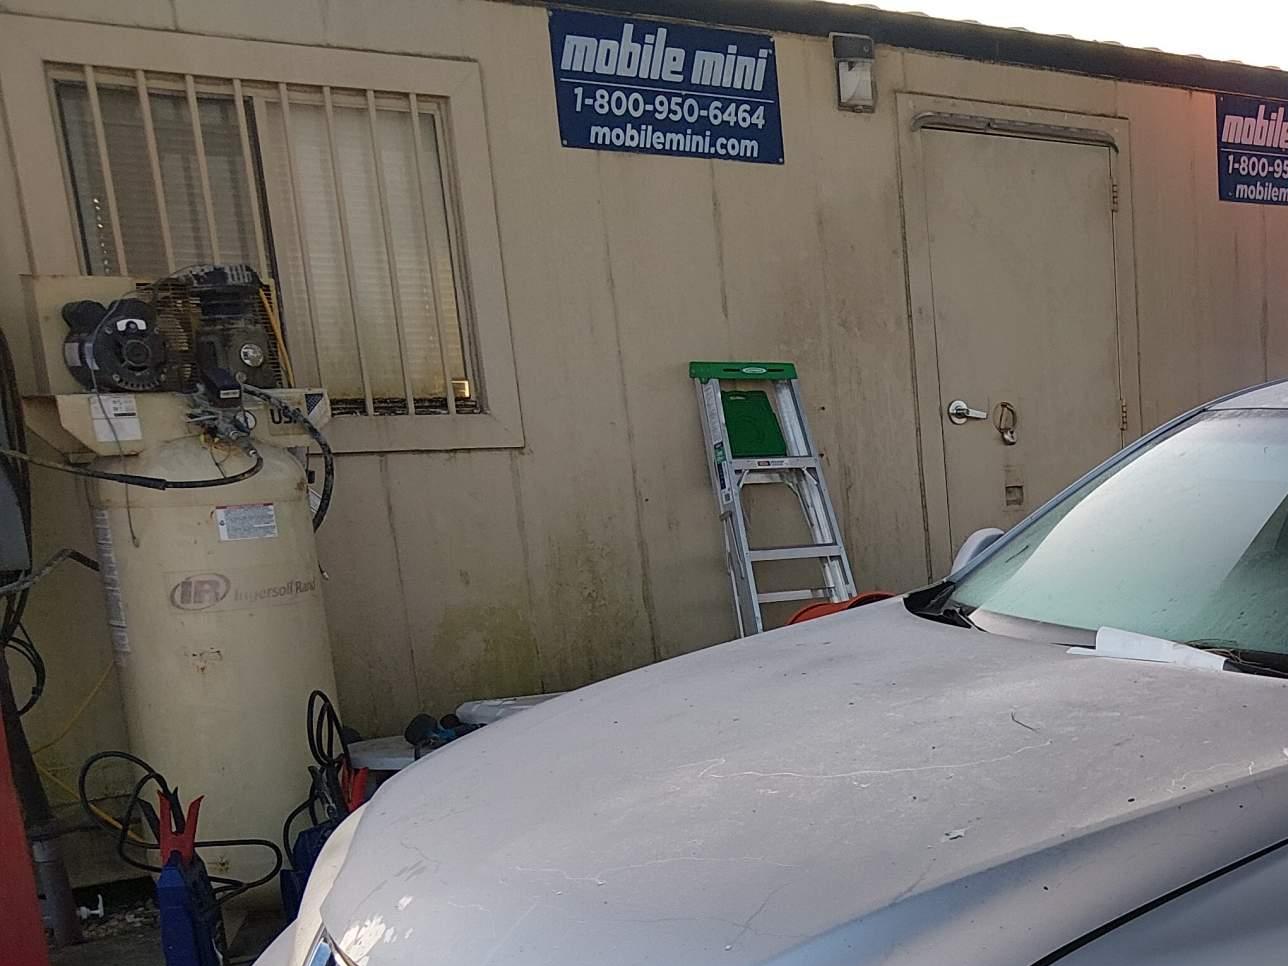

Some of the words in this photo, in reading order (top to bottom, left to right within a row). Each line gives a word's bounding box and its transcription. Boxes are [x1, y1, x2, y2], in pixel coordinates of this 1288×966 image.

[561, 23, 686, 83] mobile
[691, 45, 768, 91] mini
[574, 87, 766, 129] 1-800-950-6464
[590, 123, 759, 158] mobilemini.com
